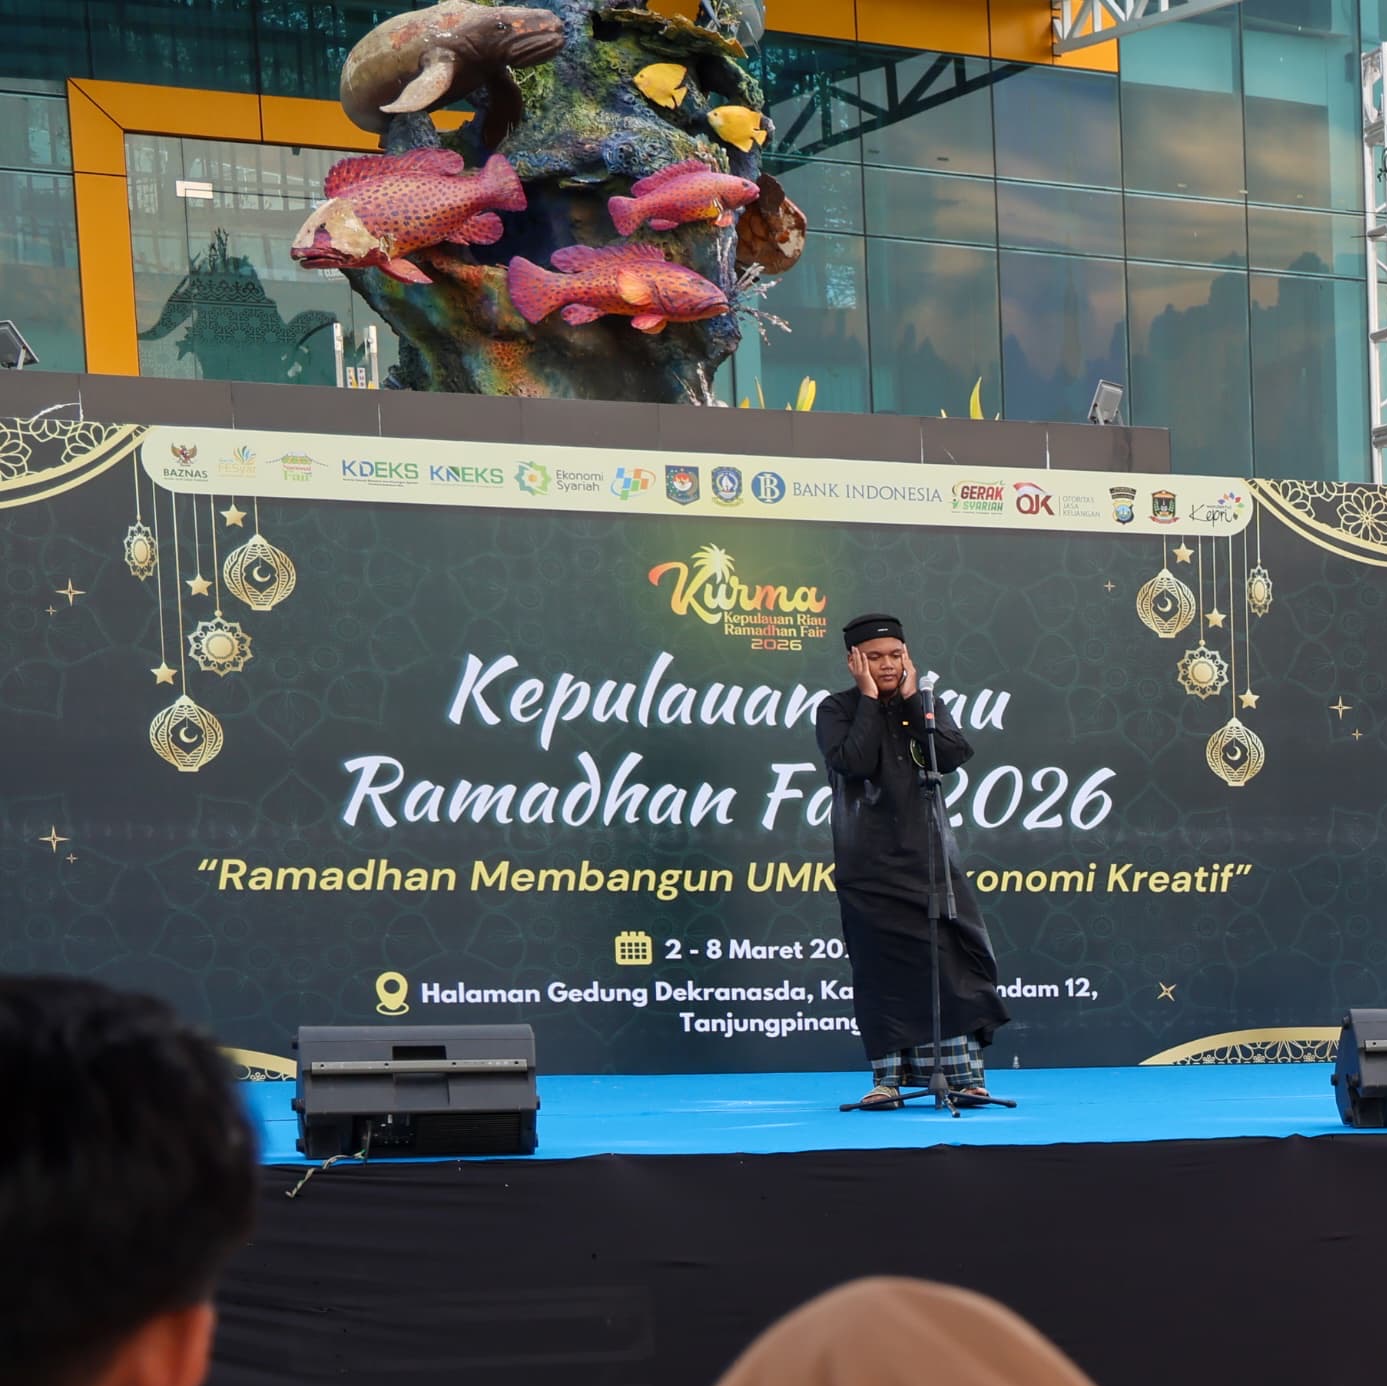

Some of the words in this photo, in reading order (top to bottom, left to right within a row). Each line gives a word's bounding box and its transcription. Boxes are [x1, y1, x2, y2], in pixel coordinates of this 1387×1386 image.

[163, 468, 208, 479] BAZNAS
[341, 459, 419, 479] KDEKS
[429, 464, 504, 484] KNEKS
[555, 469, 604, 482] Ekonomi
[557, 480, 600, 493] Syariah
[792, 481, 840, 498] BANK
[845, 483, 943, 503] INDONESIA
[960, 485, 1005, 501] GERAK
[962, 500, 1004, 512] SYARIAH
[1188, 504, 1233, 528] Kepri
[647, 558, 829, 625] Kurma
[723, 611, 794, 627] Kepulauan
[796, 613, 827, 627] Riau
[724, 623, 798, 637] Ramadhan
[799, 626, 827, 638] Fair
[751, 639, 803, 651] 2026
[448, 651, 831, 751] Kepulauan
[342, 751, 734, 830] Ramadhan
[761, 762, 832, 831] Fa
[470, 859, 734, 902] Membangun
[746, 861, 837, 893] UMK
[966, 862, 1098, 893] onomi
[664, 938, 682, 960] 2
[706, 938, 723, 960] 8
[729, 938, 804, 960] Maret
[809, 938, 850, 960] 20
[421, 982, 541, 1004] Halaman
[547, 981, 649, 1008] Gedung
[655, 980, 815, 1005] Dekranasda,
[1064, 977, 1099, 1001] 12,
